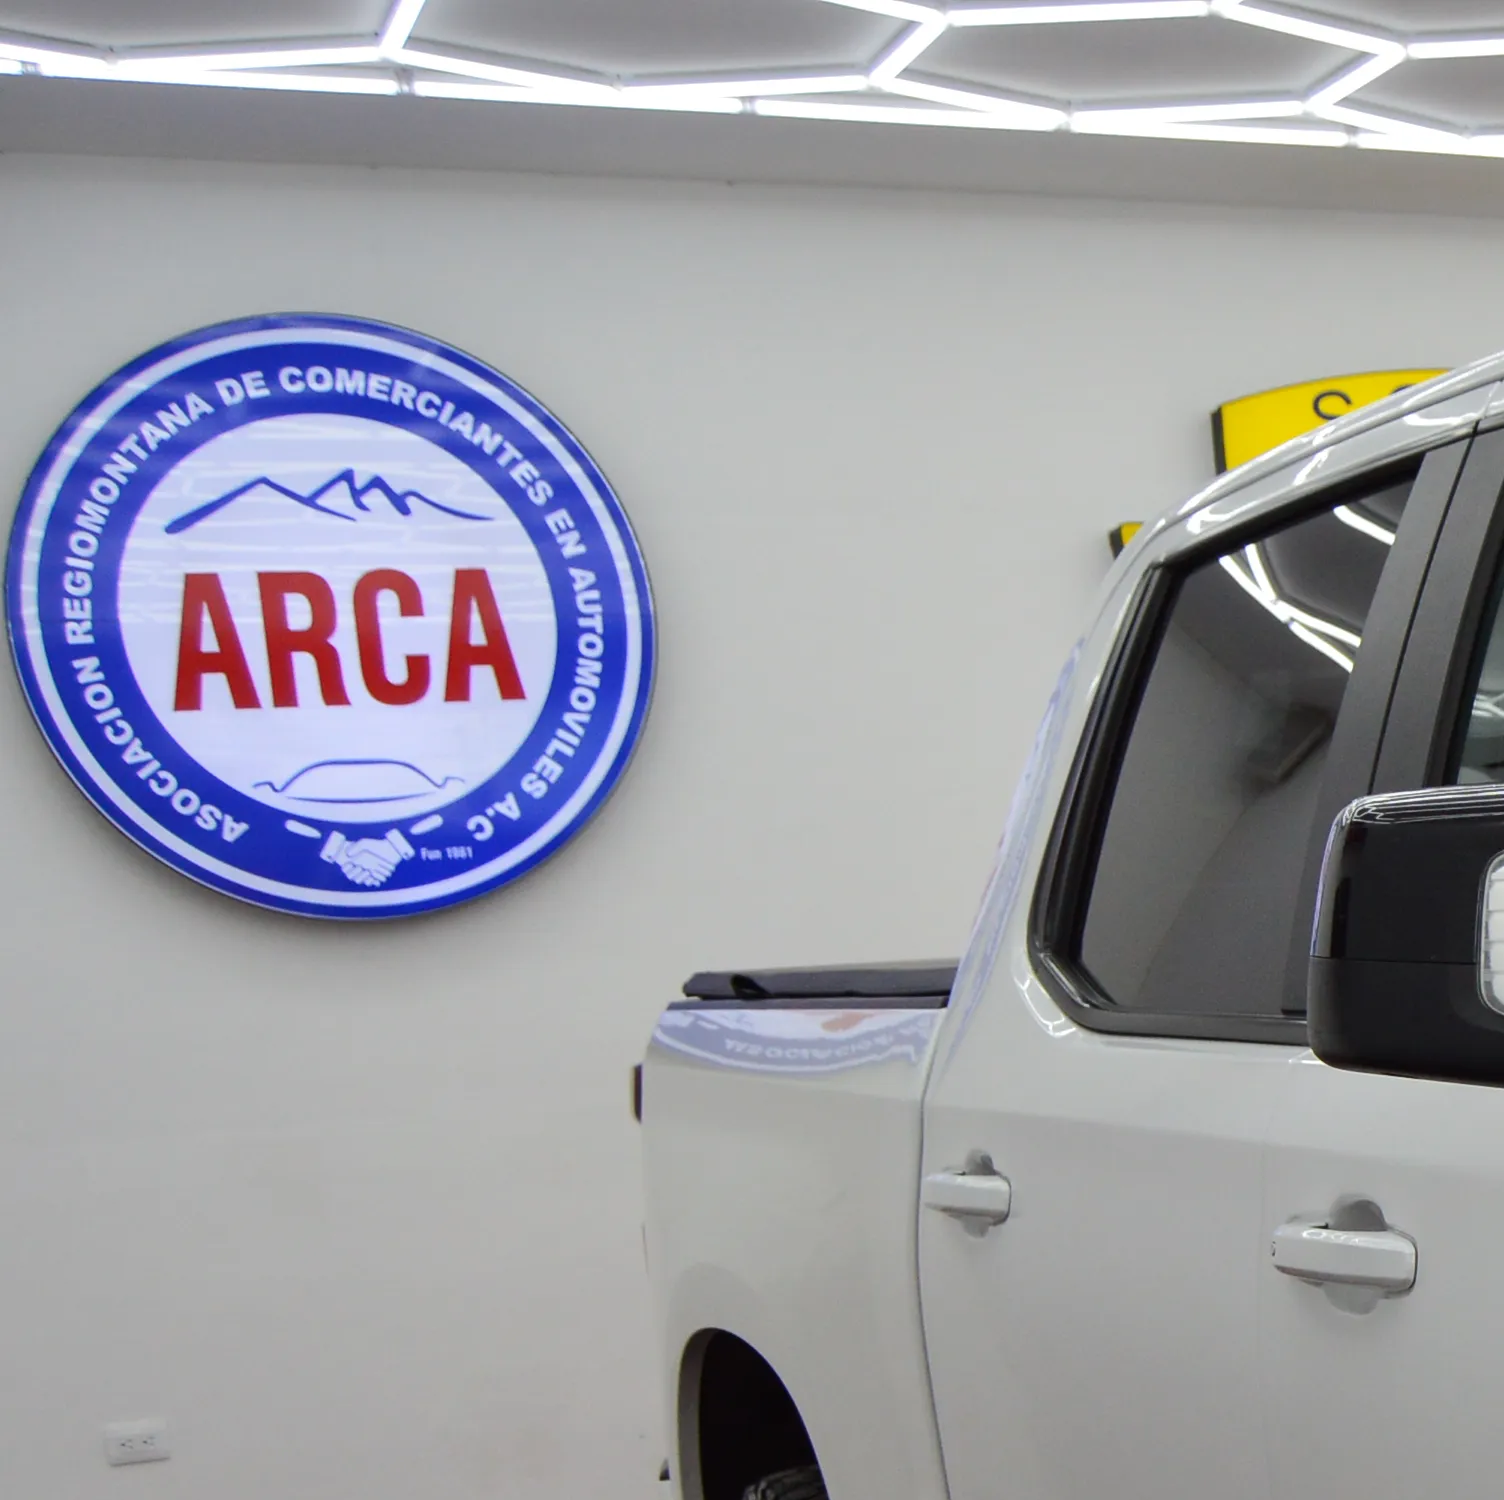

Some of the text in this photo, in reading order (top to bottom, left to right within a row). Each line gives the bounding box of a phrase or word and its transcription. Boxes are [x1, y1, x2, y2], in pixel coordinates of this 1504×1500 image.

[215, 370, 271, 407] DE
[278, 365, 555, 508] COMERCIANTES
[62, 391, 215, 645] REGIOMONTANA
[545, 507, 587, 560] EN
[173, 567, 527, 712] ARCA
[520, 566, 605, 799] AUTOMOVILES
[70, 656, 249, 843] ASOCIACION
